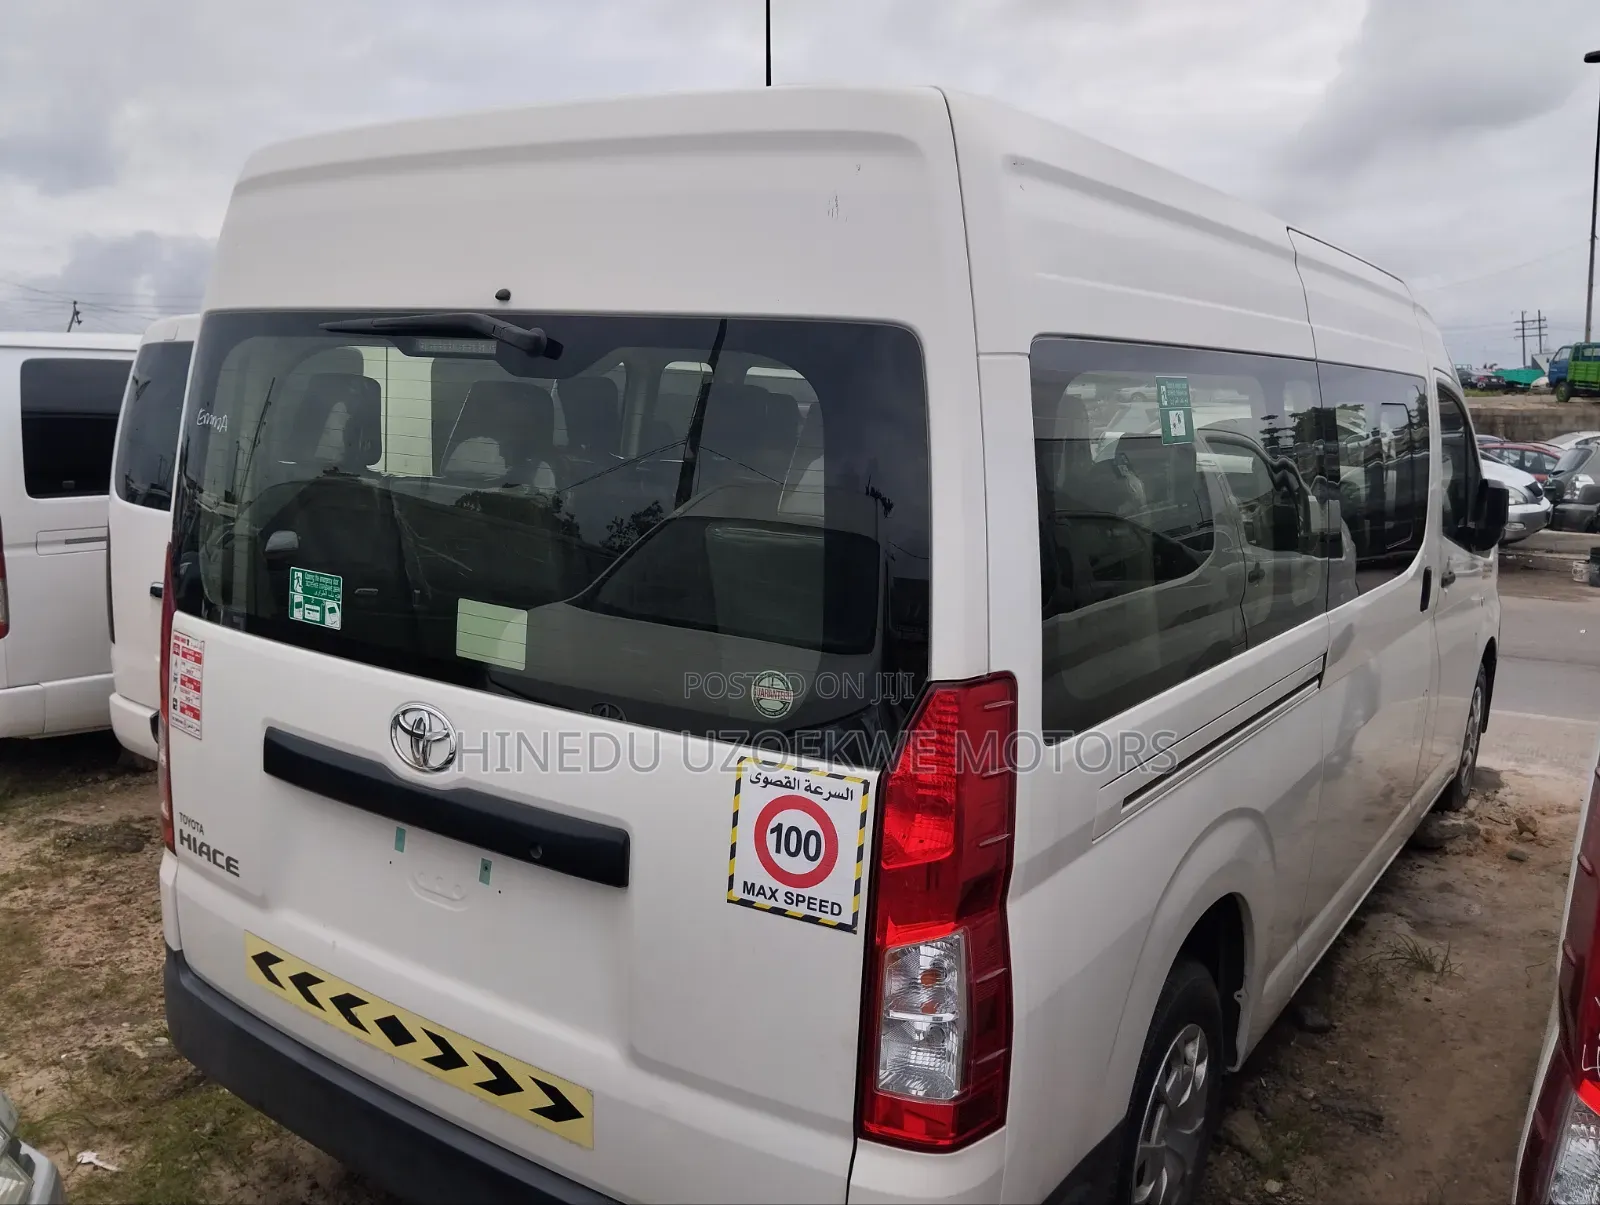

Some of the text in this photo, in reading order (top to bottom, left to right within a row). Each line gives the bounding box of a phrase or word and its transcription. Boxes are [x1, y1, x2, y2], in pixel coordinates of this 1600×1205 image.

[749, 771, 854, 802] السرعة القصوى
[179, 811, 205, 836] TOYOTA
[179, 828, 240, 878] HIACE
[769, 822, 823, 863] 100
[742, 880, 843, 917] MAX SPEED
